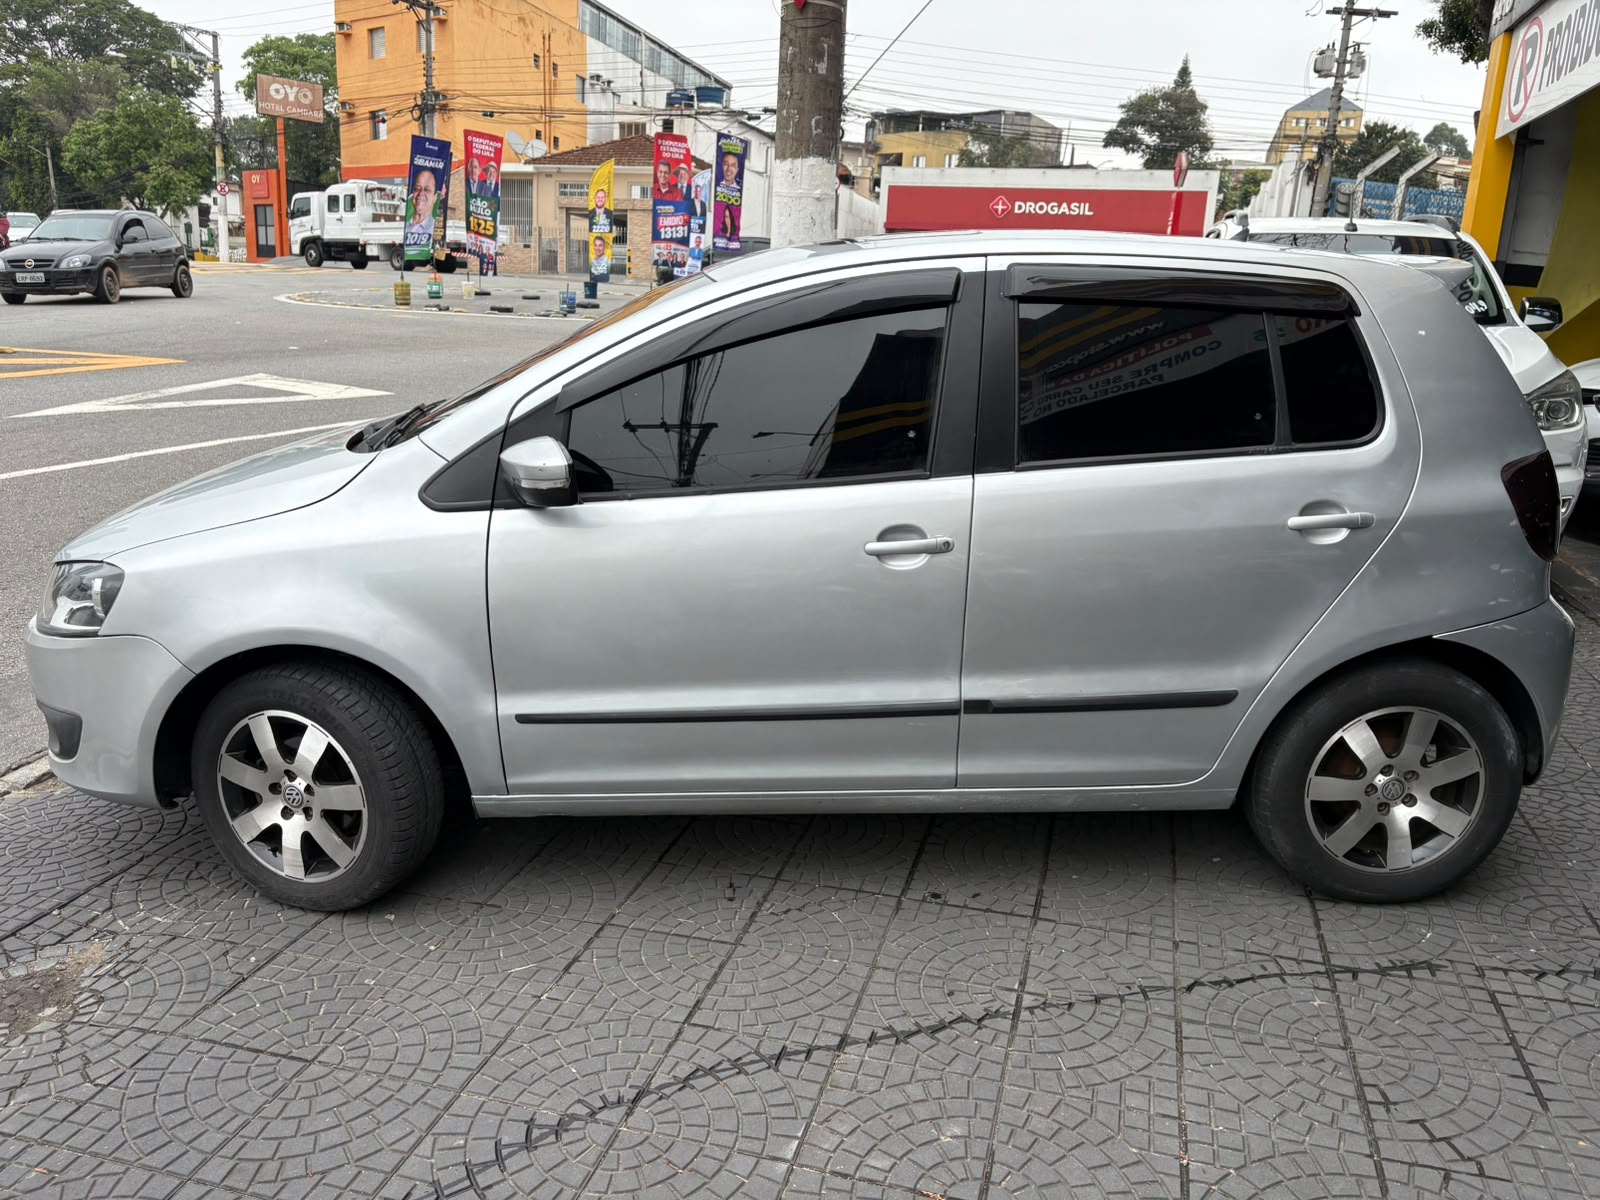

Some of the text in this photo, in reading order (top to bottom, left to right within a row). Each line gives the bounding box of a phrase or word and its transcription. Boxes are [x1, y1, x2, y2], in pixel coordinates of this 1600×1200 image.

[269, 83, 314, 105] OYO
[259, 101, 284, 113] HOTEL
[472, 136, 502, 148] DEPUTADO
[472, 142, 495, 153] FEDERAL
[481, 150, 495, 158] LULA
[715, 191, 741, 205] 2000
[1013, 200, 1094, 217] DROGASIL
[659, 226, 688, 239] 13131
[405, 233, 430, 245] 1019
